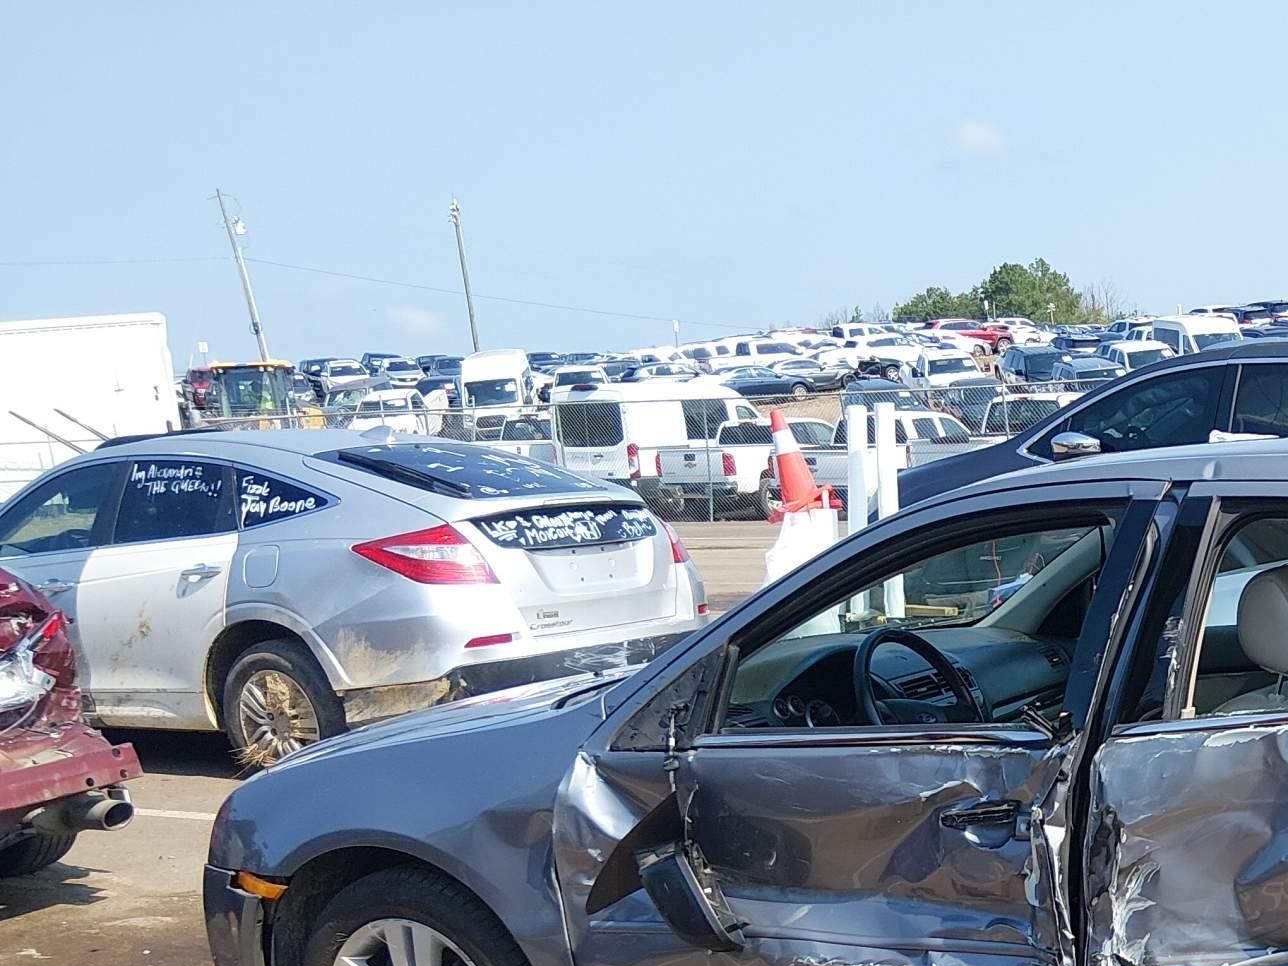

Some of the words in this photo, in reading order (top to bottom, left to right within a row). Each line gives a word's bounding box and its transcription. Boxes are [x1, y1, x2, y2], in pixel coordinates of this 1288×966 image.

[143, 479, 168, 496] THE
[241, 494, 267, 518] Jay
[268, 495, 316, 514] Boone
